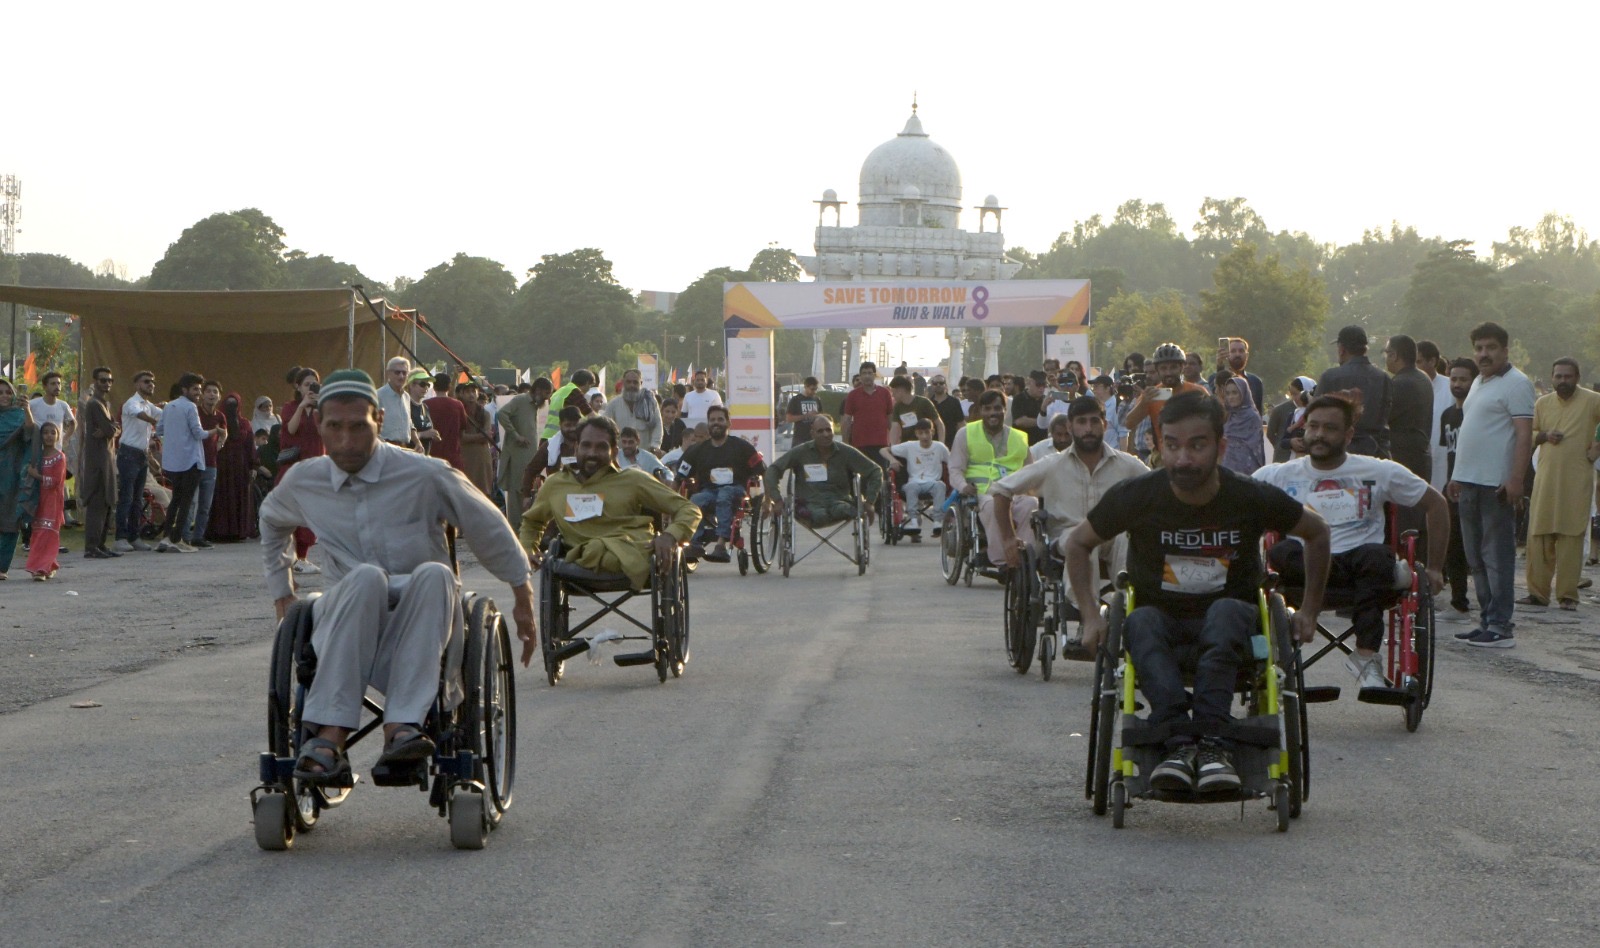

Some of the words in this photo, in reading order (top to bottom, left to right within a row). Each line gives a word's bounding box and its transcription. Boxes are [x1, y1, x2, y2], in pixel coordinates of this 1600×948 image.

[824, 287, 865, 304] SAVE
[869, 287, 967, 304] TOMORROW
[972, 285, 989, 320] 8
[893, 306, 917, 320] RUN
[919, 306, 928, 320] &
[932, 305, 966, 320] WALK
[801, 403, 818, 413] RUN
[1161, 530, 1240, 546] REDLIFE
